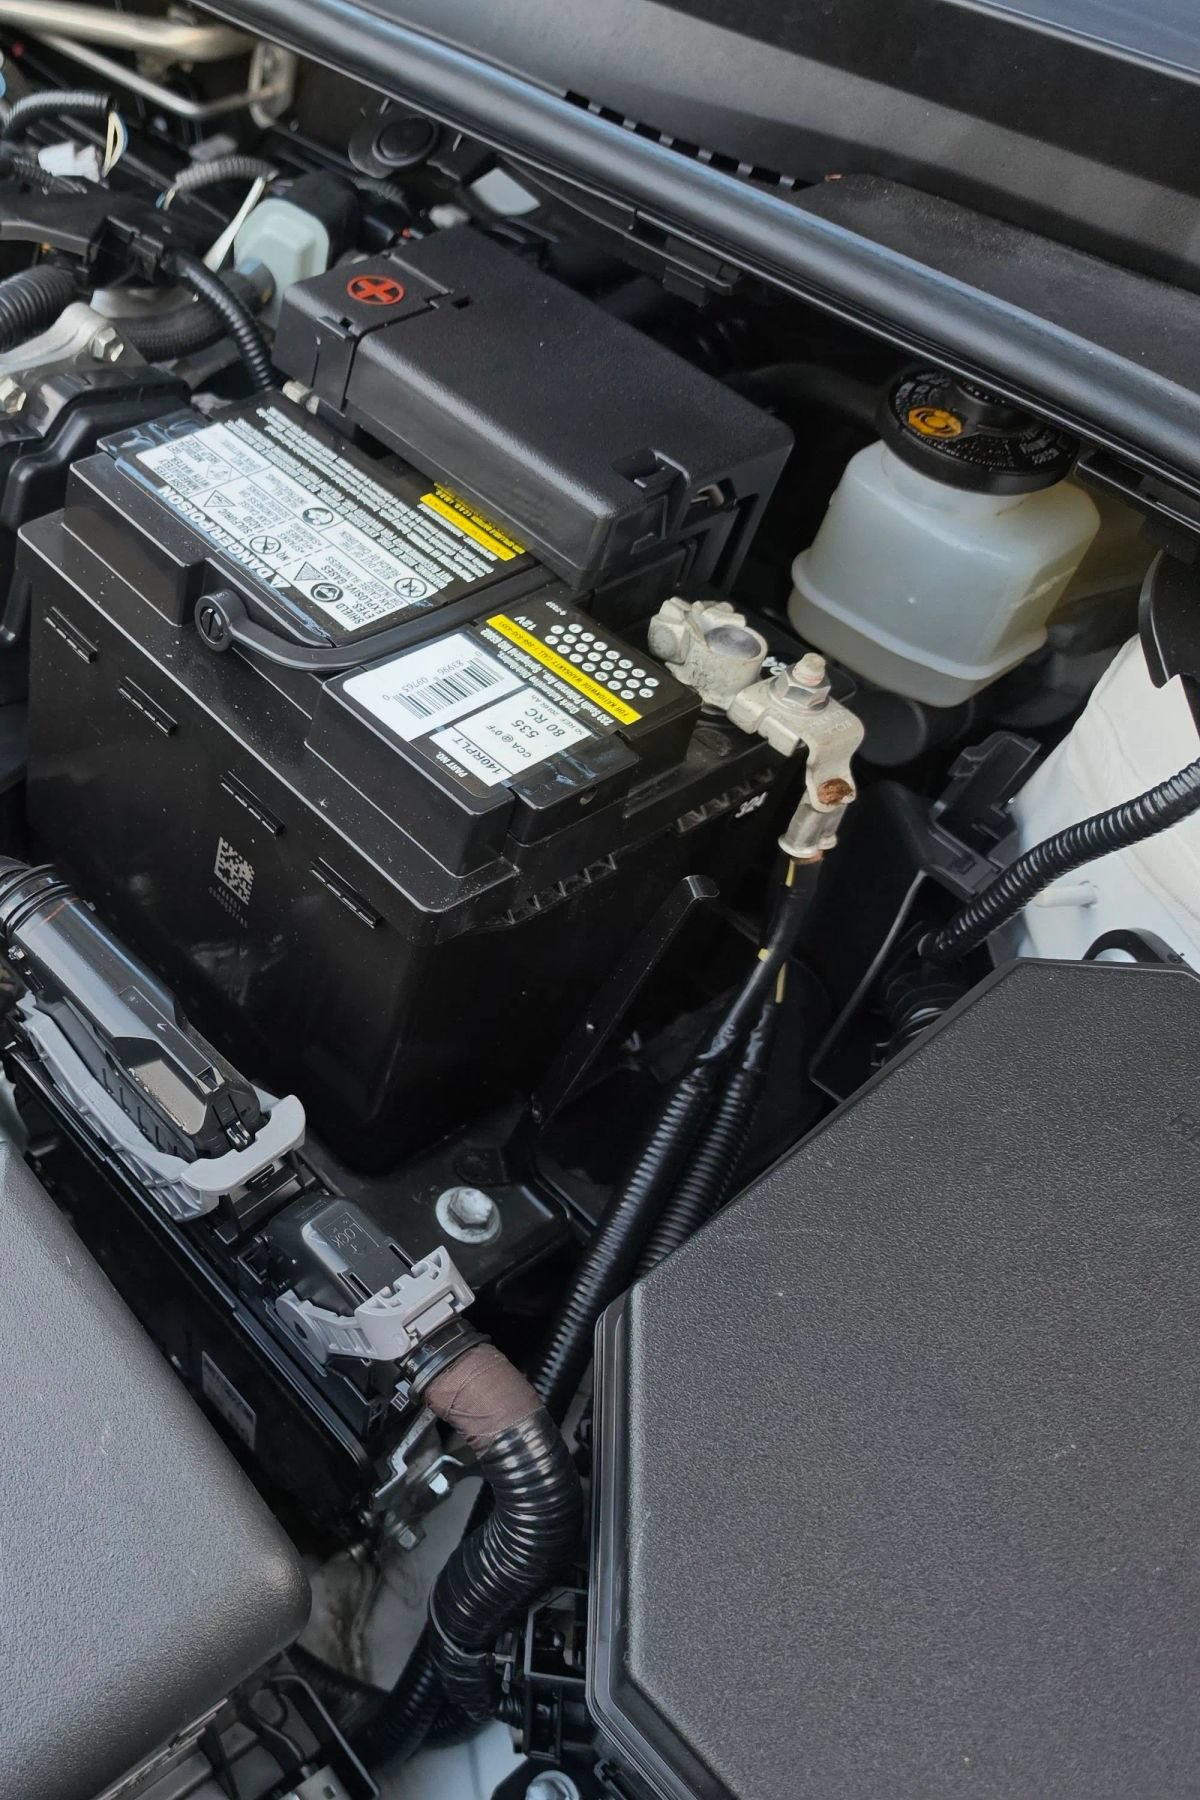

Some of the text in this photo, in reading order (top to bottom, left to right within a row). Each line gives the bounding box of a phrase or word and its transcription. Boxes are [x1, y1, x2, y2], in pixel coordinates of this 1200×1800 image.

[152, 465, 174, 479] EYES
[159, 487, 272, 575] DANGER/POISON
[217, 508, 252, 533] SULFURIC
[241, 515, 263, 529] ACID
[320, 565, 385, 613] EXPLOSIVE GASES
[334, 602, 365, 624] SHIELD
[513, 614, 539, 630] 12V
[510, 719, 540, 738] 535
[523, 707, 566, 737] 80 RC
[594, 713, 615, 725] 233
[499, 734, 515, 743] @
[450, 737, 504, 773] 140RPLT
[509, 742, 533, 758] CCA
[432, 751, 468, 777] PART NO.
[331, 1222, 363, 1249] LOCK
